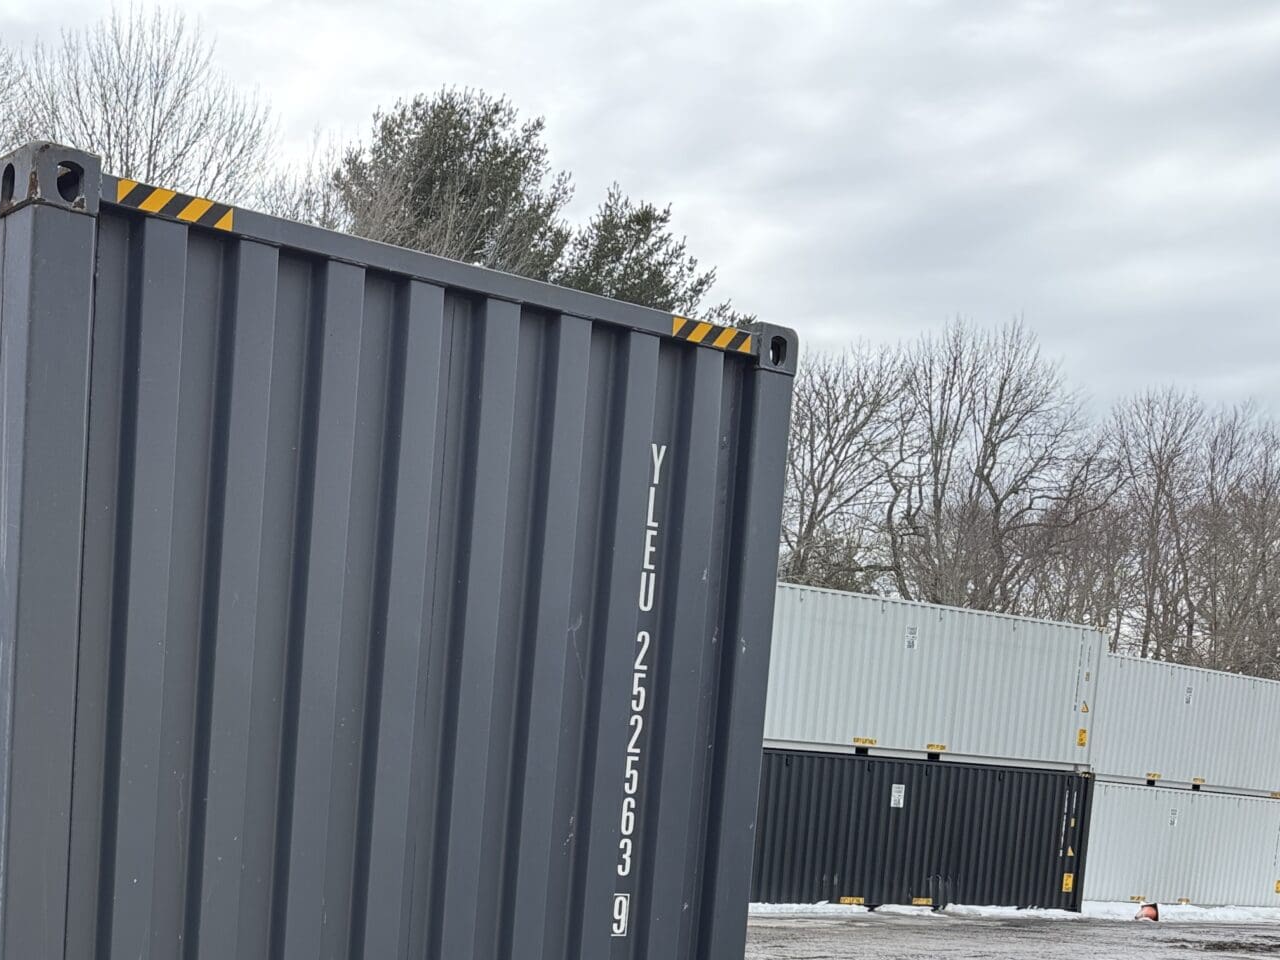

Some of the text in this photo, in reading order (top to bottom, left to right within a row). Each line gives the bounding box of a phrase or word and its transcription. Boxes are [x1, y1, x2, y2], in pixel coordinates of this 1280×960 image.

[611, 443, 667, 935] YLEU 252563 9
